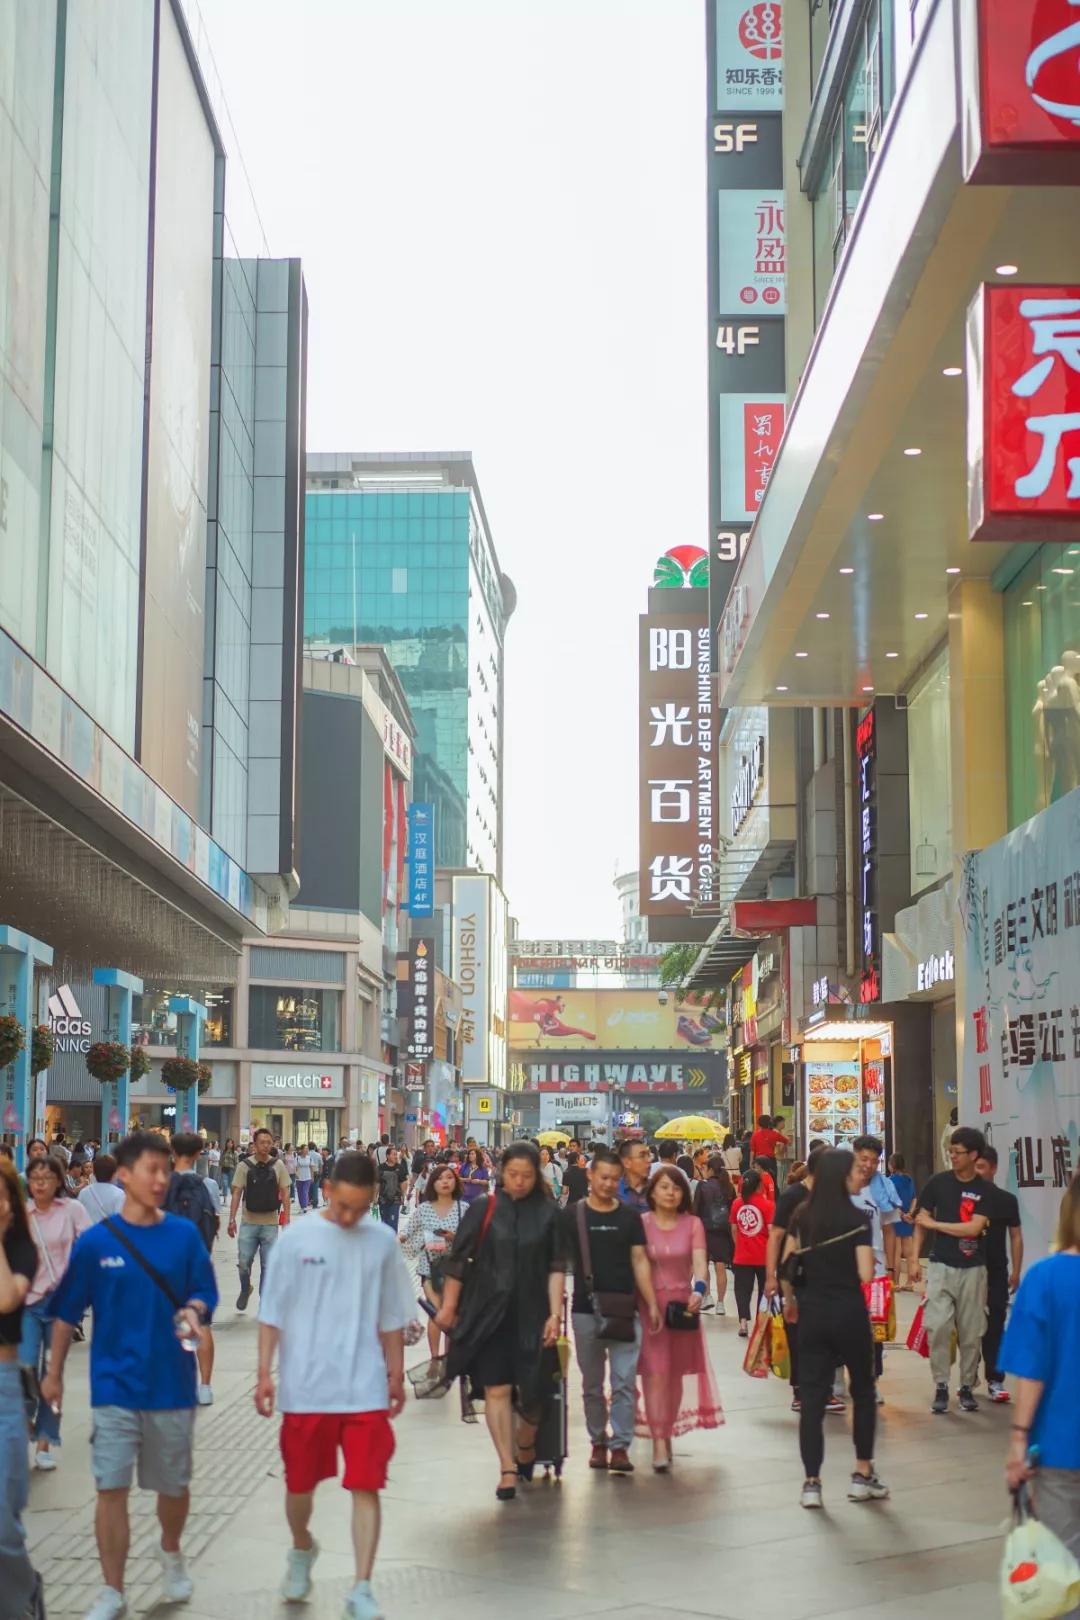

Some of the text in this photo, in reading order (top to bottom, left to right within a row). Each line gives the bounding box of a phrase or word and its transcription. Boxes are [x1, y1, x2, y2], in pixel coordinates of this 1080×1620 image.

[726, 68, 782, 85] 知乐香
[726, 87, 775, 95] SINCE 1999
[716, 326, 759, 355] 4F
[698, 628, 711, 714] SUNSHINE
[698, 719, 711, 752] DEP
[648, 627, 693, 901] 阳光百货
[698, 757, 712, 839] ARTMENT
[414, 832, 428, 890] 汉庭酒店
[414, 893, 428, 902] 4F
[265, 1073, 321, 1089] swatch
[530, 1064, 684, 1082] HIGHWAVE
